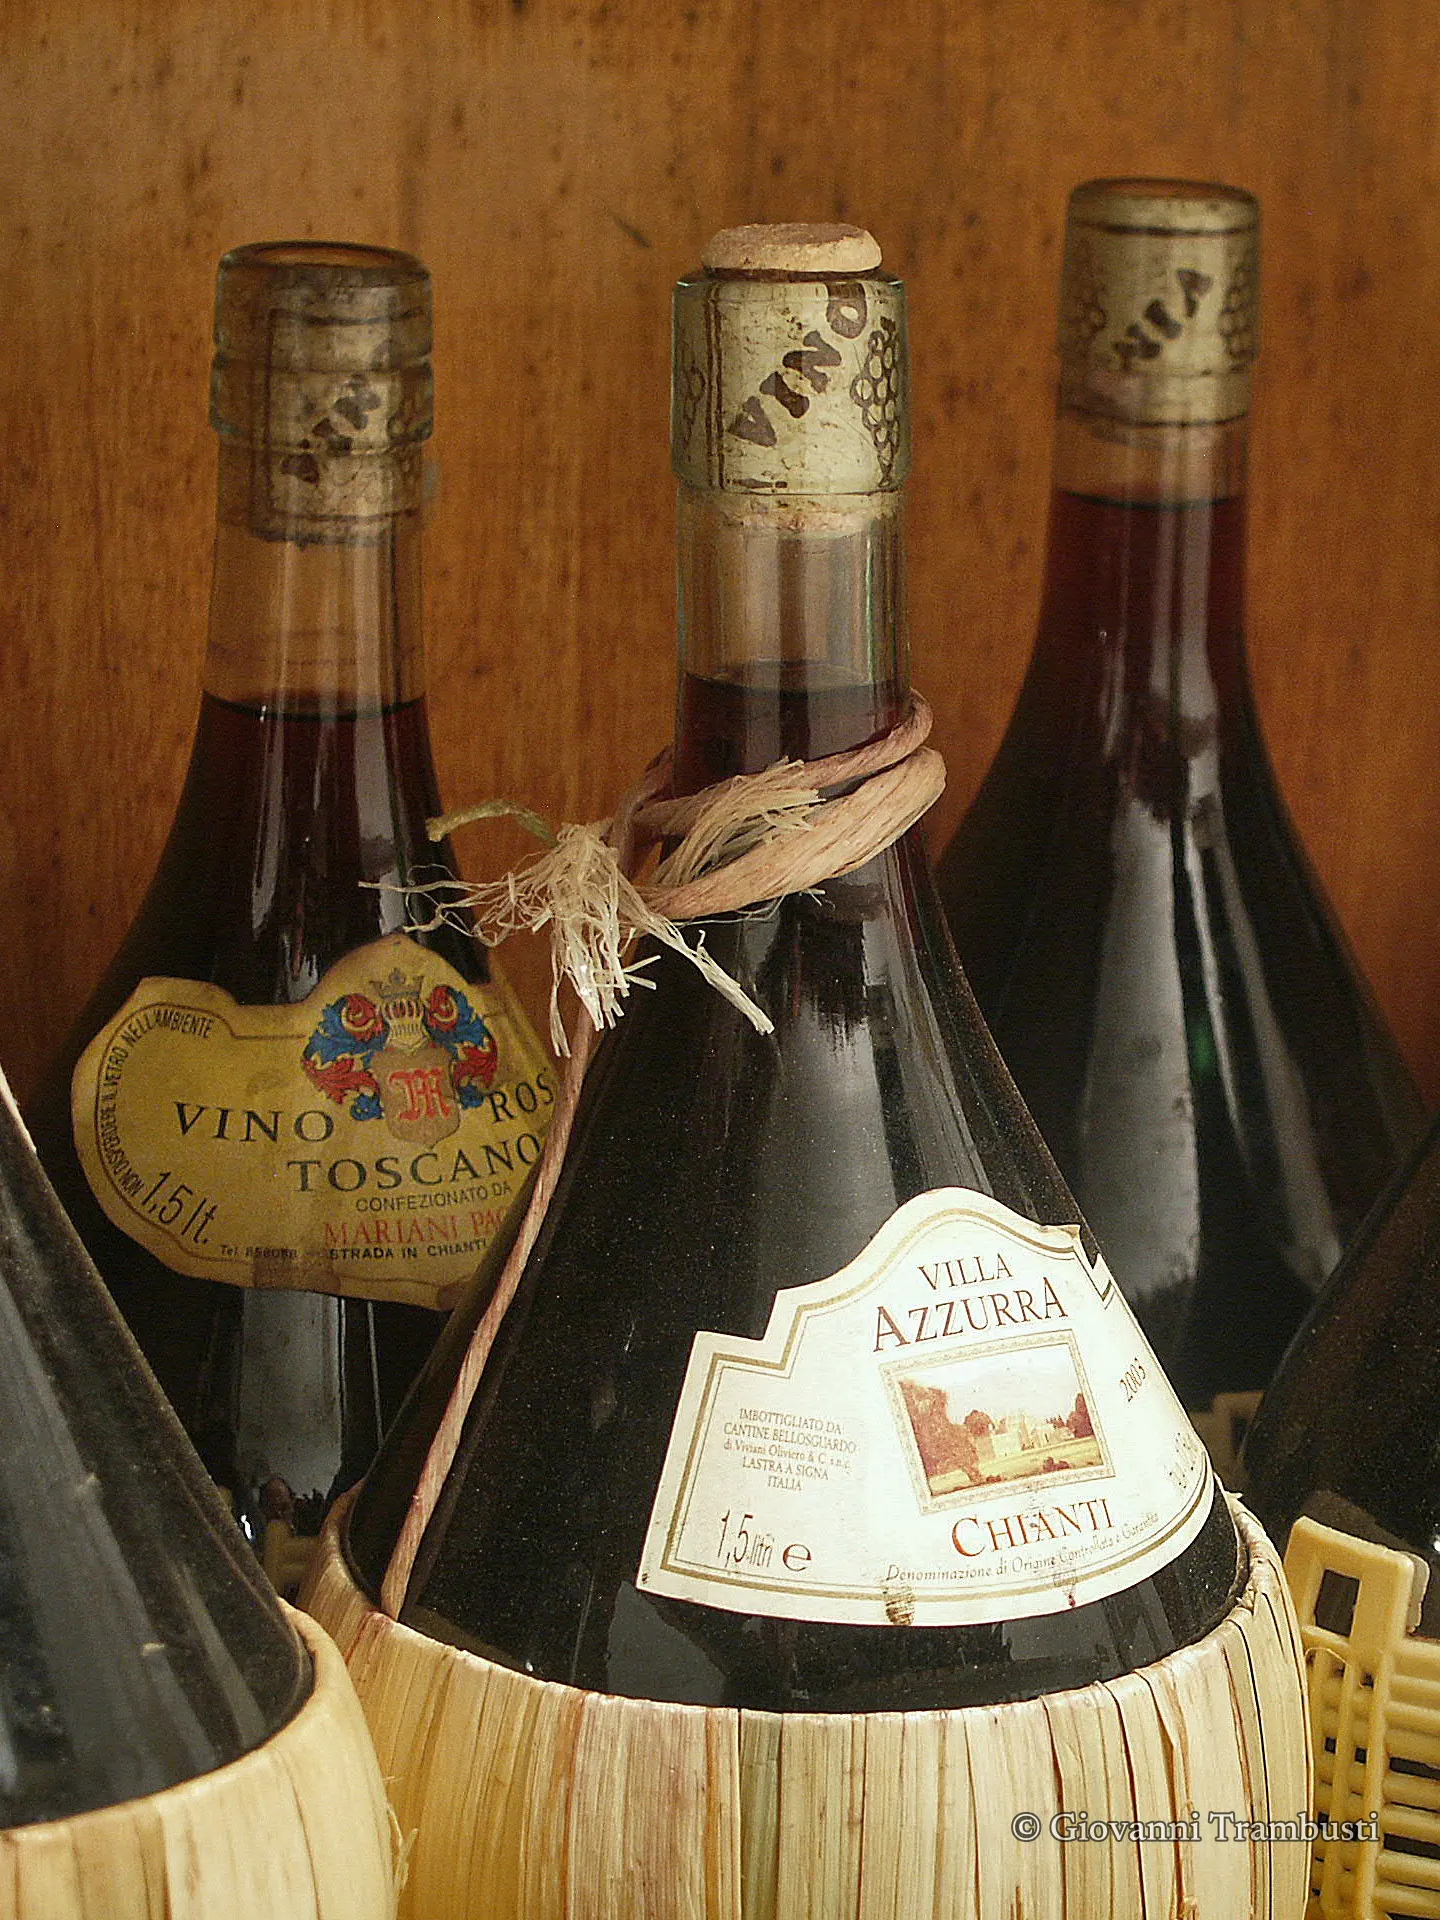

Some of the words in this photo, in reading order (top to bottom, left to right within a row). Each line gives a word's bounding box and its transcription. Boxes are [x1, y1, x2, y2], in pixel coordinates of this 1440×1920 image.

[727, 281, 869, 447] VINO
[173, 1101, 335, 1144] VINO
[486, 1070, 555, 1125] ROS
[286, 1132, 541, 1193] TOSCANO
[142, 1171, 194, 1226] 1,5
[355, 1185, 489, 1213] CONFEZIONATO
[491, 1181, 512, 1197] DA
[322, 1214, 460, 1248] MARIANI
[328, 1247, 394, 1261] STRADA
[402, 1247, 418, 1259] IN
[426, 1237, 486, 1258] CHIANTI
[917, 1252, 1013, 1291] VILLA
[873, 1276, 1069, 1353] AZZURRA
[1119, 1357, 1147, 1403] 2003
[738, 1407, 824, 1431] IMBOTTIGLIATO
[723, 1421, 770, 1440] CANTINE
[771, 1428, 857, 1454] BELLOSGUARDO
[723, 1438, 732, 1450] di
[742, 1456, 783, 1473] LASTRA
[784, 1462, 793, 1475] A
[796, 1464, 829, 1480] SIGNA
[767, 1475, 803, 1491] ITALIA
[717, 1509, 754, 1568] 1,5
[951, 1498, 1116, 1557] CHIANTI
[886, 1562, 993, 1582] Denominazione
[995, 1557, 1008, 1576] di
[1011, 1555, 1057, 1577] Origine
